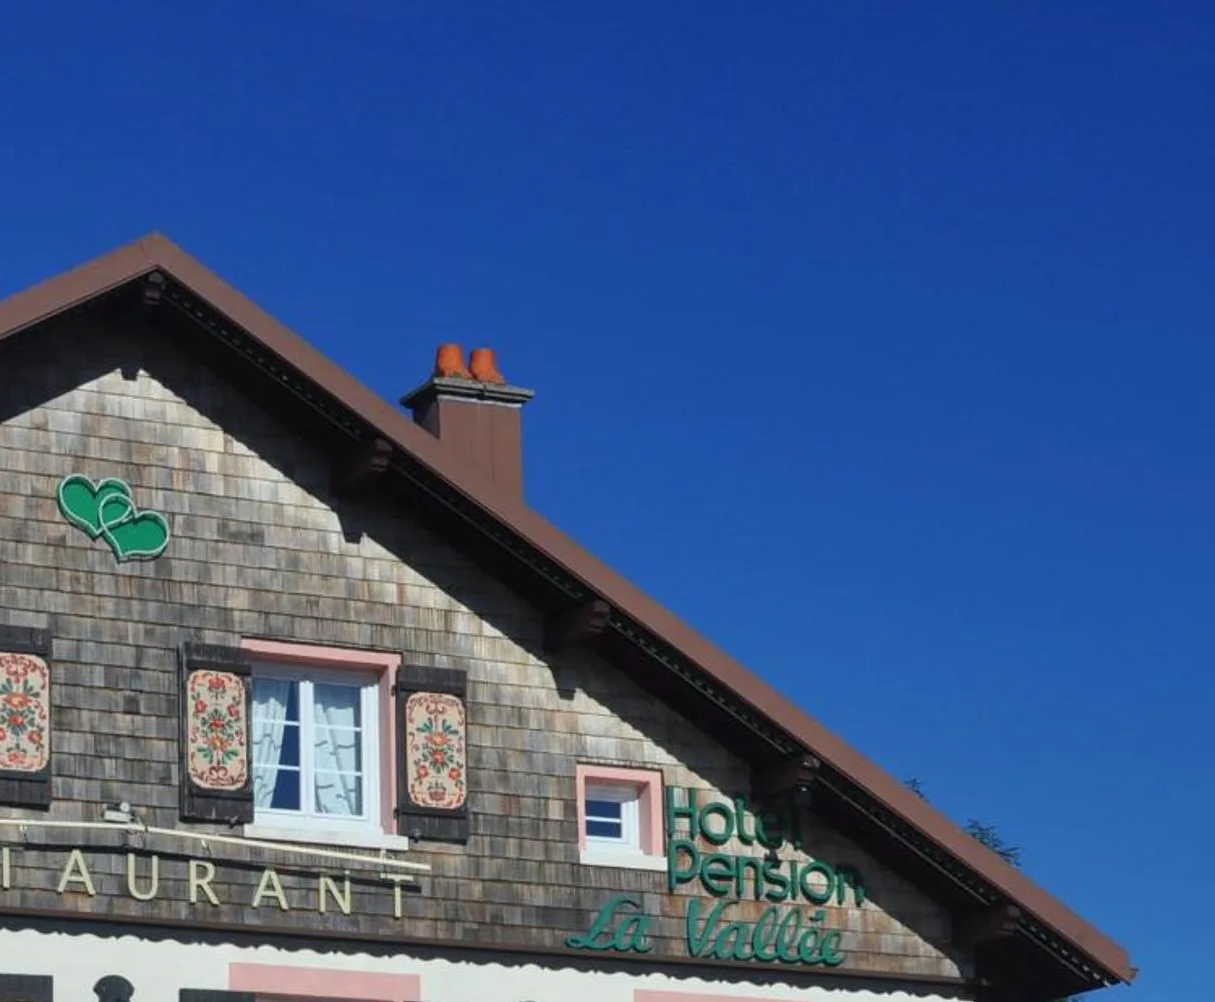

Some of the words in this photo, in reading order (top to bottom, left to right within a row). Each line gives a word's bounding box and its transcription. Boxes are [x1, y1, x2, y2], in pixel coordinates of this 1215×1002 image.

[666, 785, 804, 850] Hotel
[566, 894, 653, 953] La
[687, 897, 847, 967] Vallée
